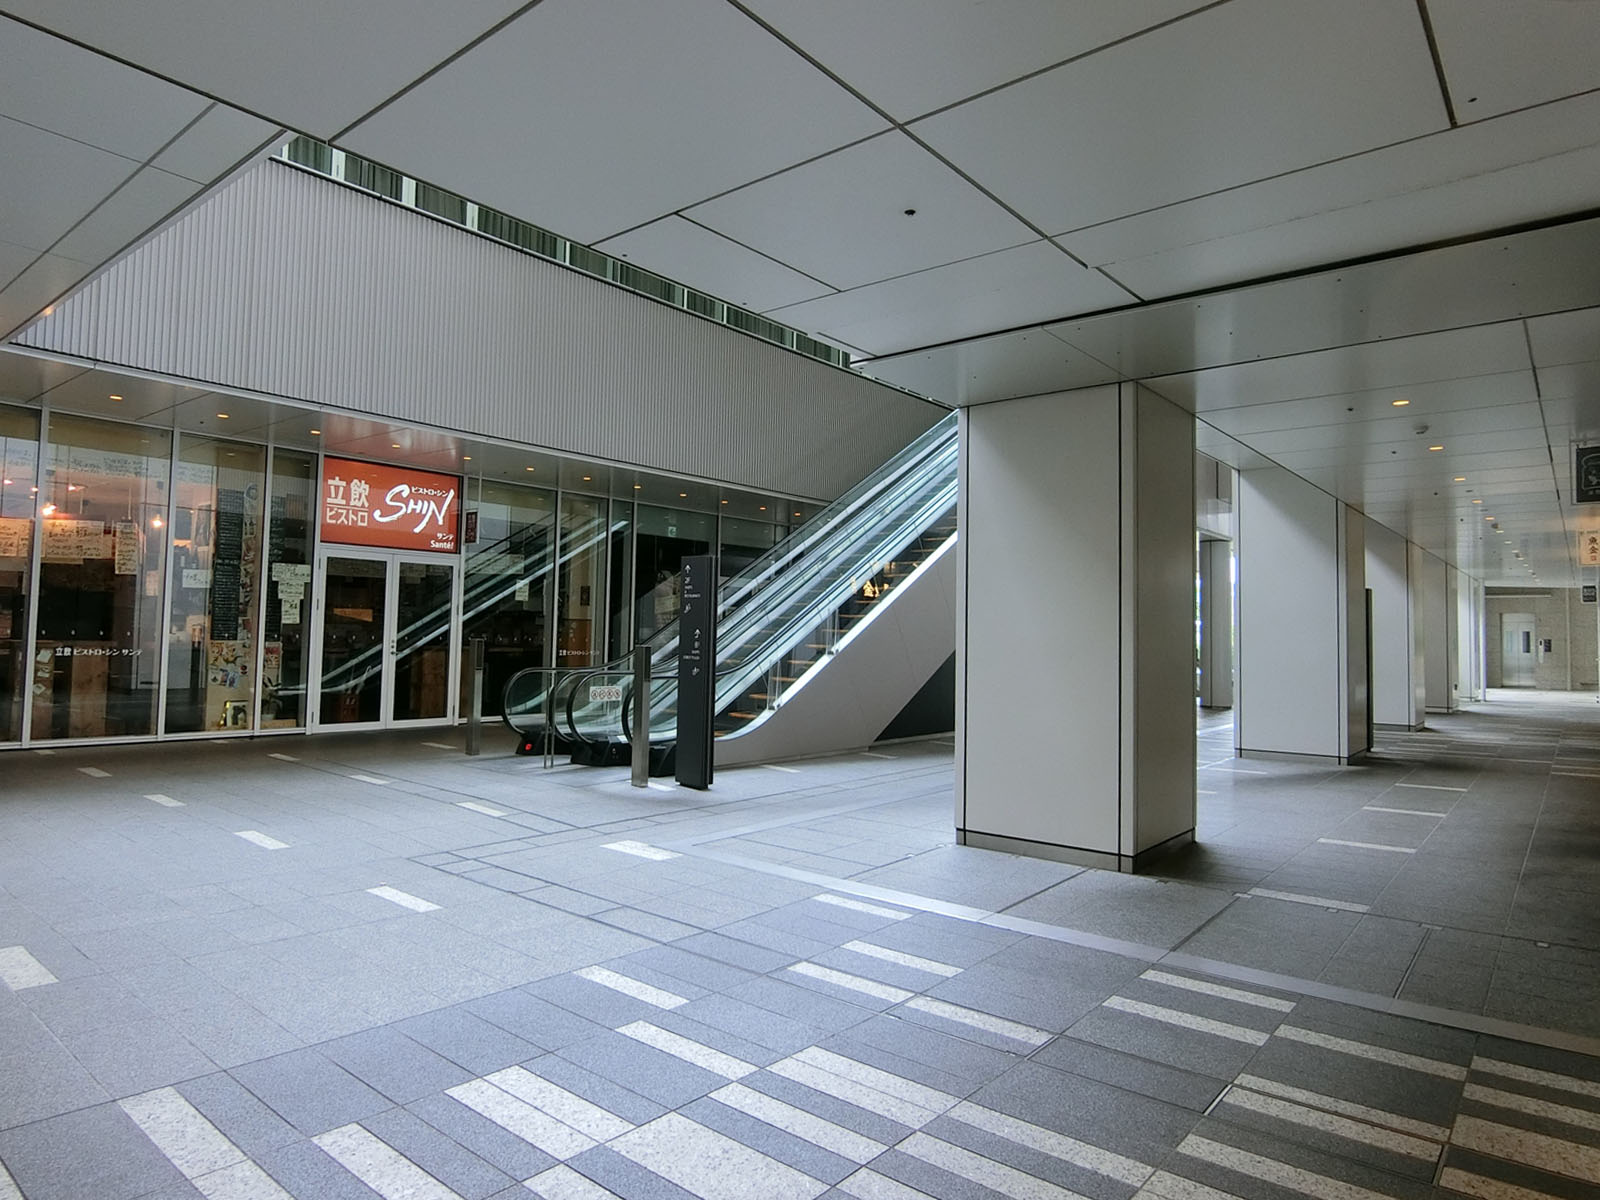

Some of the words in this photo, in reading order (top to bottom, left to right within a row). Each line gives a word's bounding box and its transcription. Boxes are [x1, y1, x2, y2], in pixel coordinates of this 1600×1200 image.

[327, 476, 370, 507] 立飲
[326, 508, 368, 527] ビストロ
[373, 484, 454, 533] SHIN
[73, 648, 120, 656] ビストロ・シン
